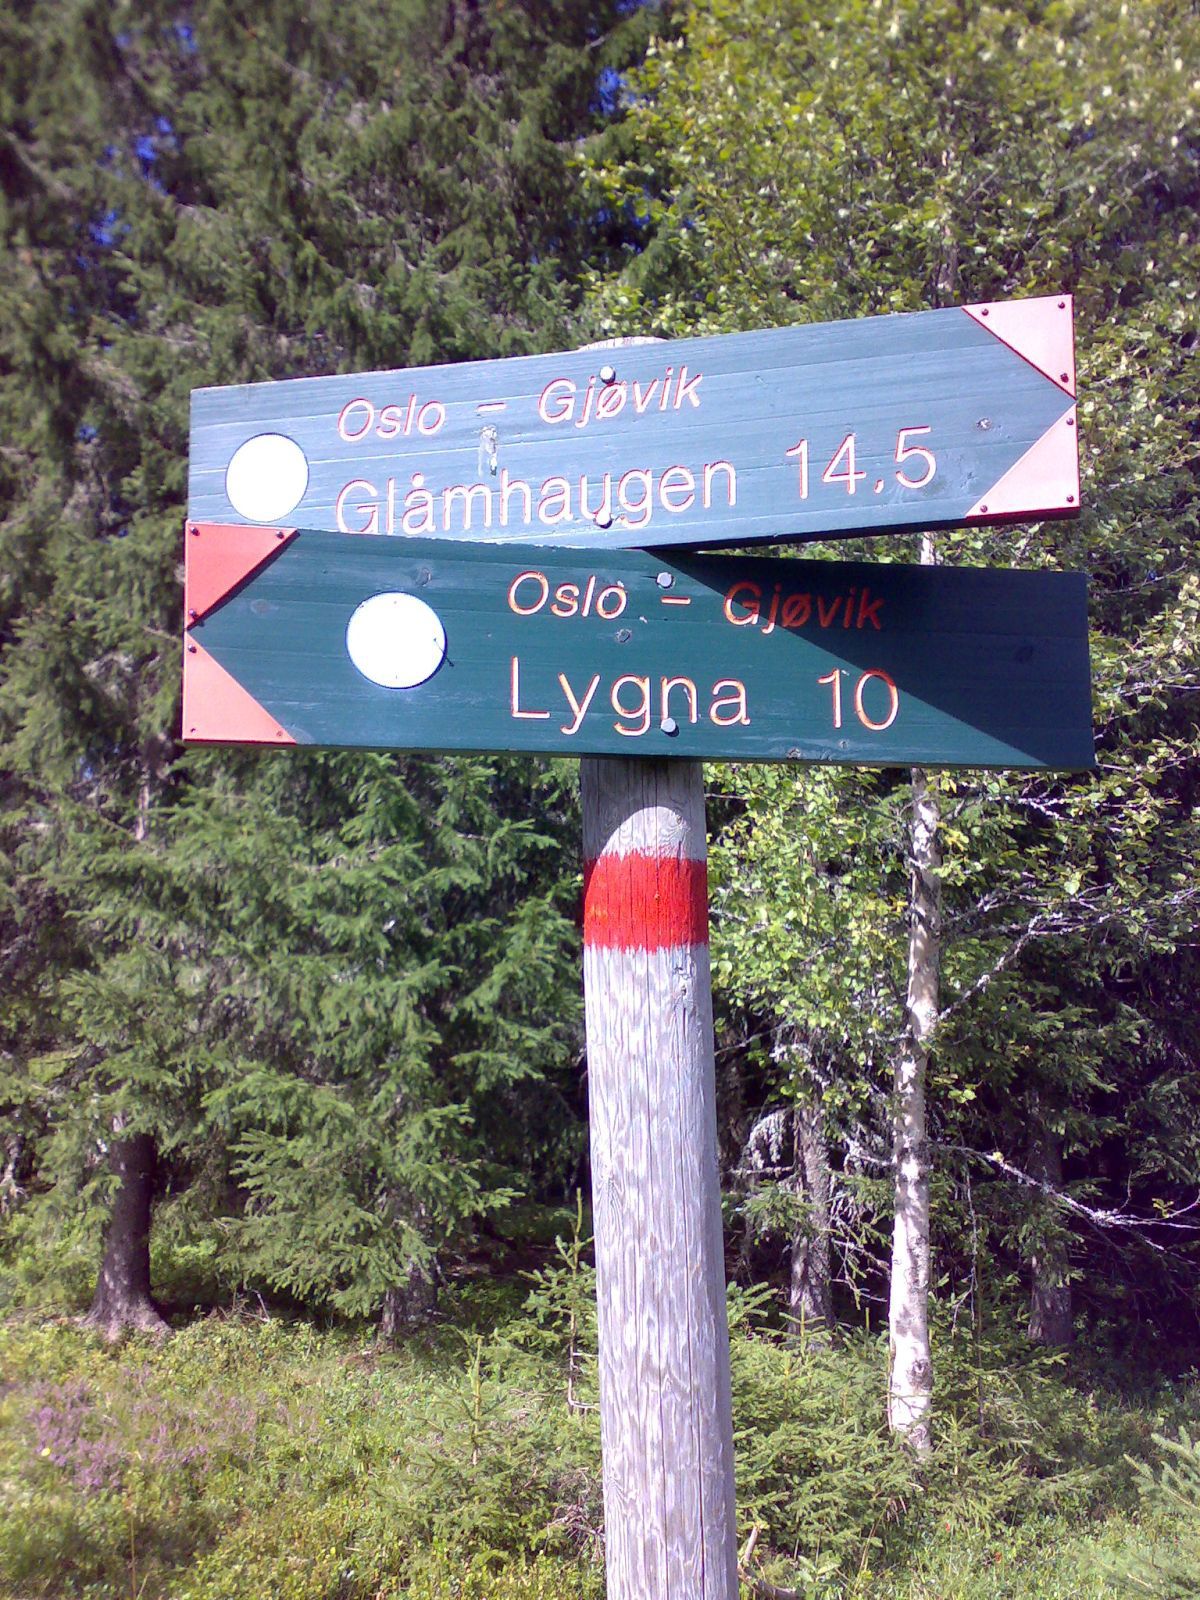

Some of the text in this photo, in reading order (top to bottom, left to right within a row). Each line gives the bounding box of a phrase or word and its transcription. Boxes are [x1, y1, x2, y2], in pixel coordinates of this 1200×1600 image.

[336, 394, 447, 442] Oslo
[538, 365, 704, 429] Gjøvik
[335, 459, 738, 536] Glåmhaugen
[508, 570, 627, 619] Oslo
[723, 581, 885, 635] Gjøvik
[511, 656, 899, 737] Lygna 10
